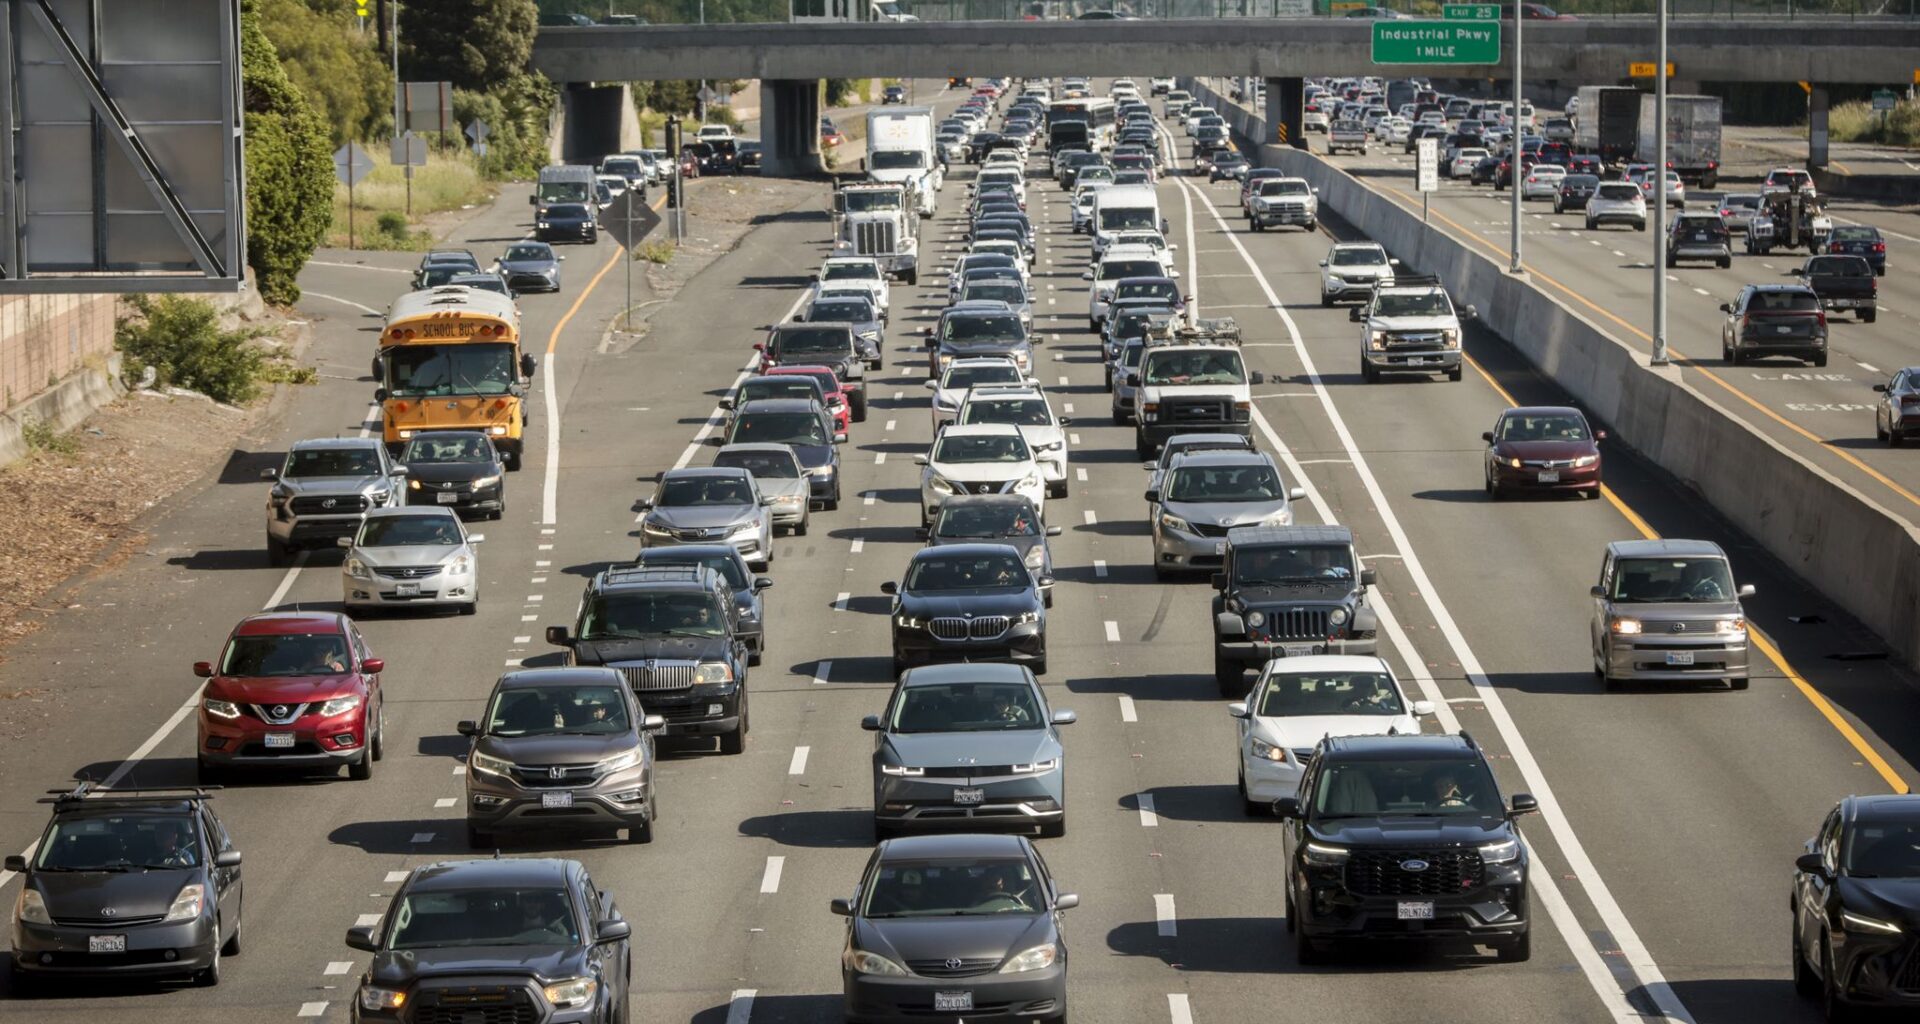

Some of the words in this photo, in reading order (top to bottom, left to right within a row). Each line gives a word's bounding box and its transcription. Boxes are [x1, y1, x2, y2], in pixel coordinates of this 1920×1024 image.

[1476, 8, 1492, 18] 25
[1381, 29, 1449, 39] Industrial
[1456, 29, 1491, 41] Pkwy
[1416, 46, 1421, 56] 1
[1425, 46, 1455, 57] MILE
[423, 322, 455, 337] SCHOOL
[458, 322, 475, 336] BUS
